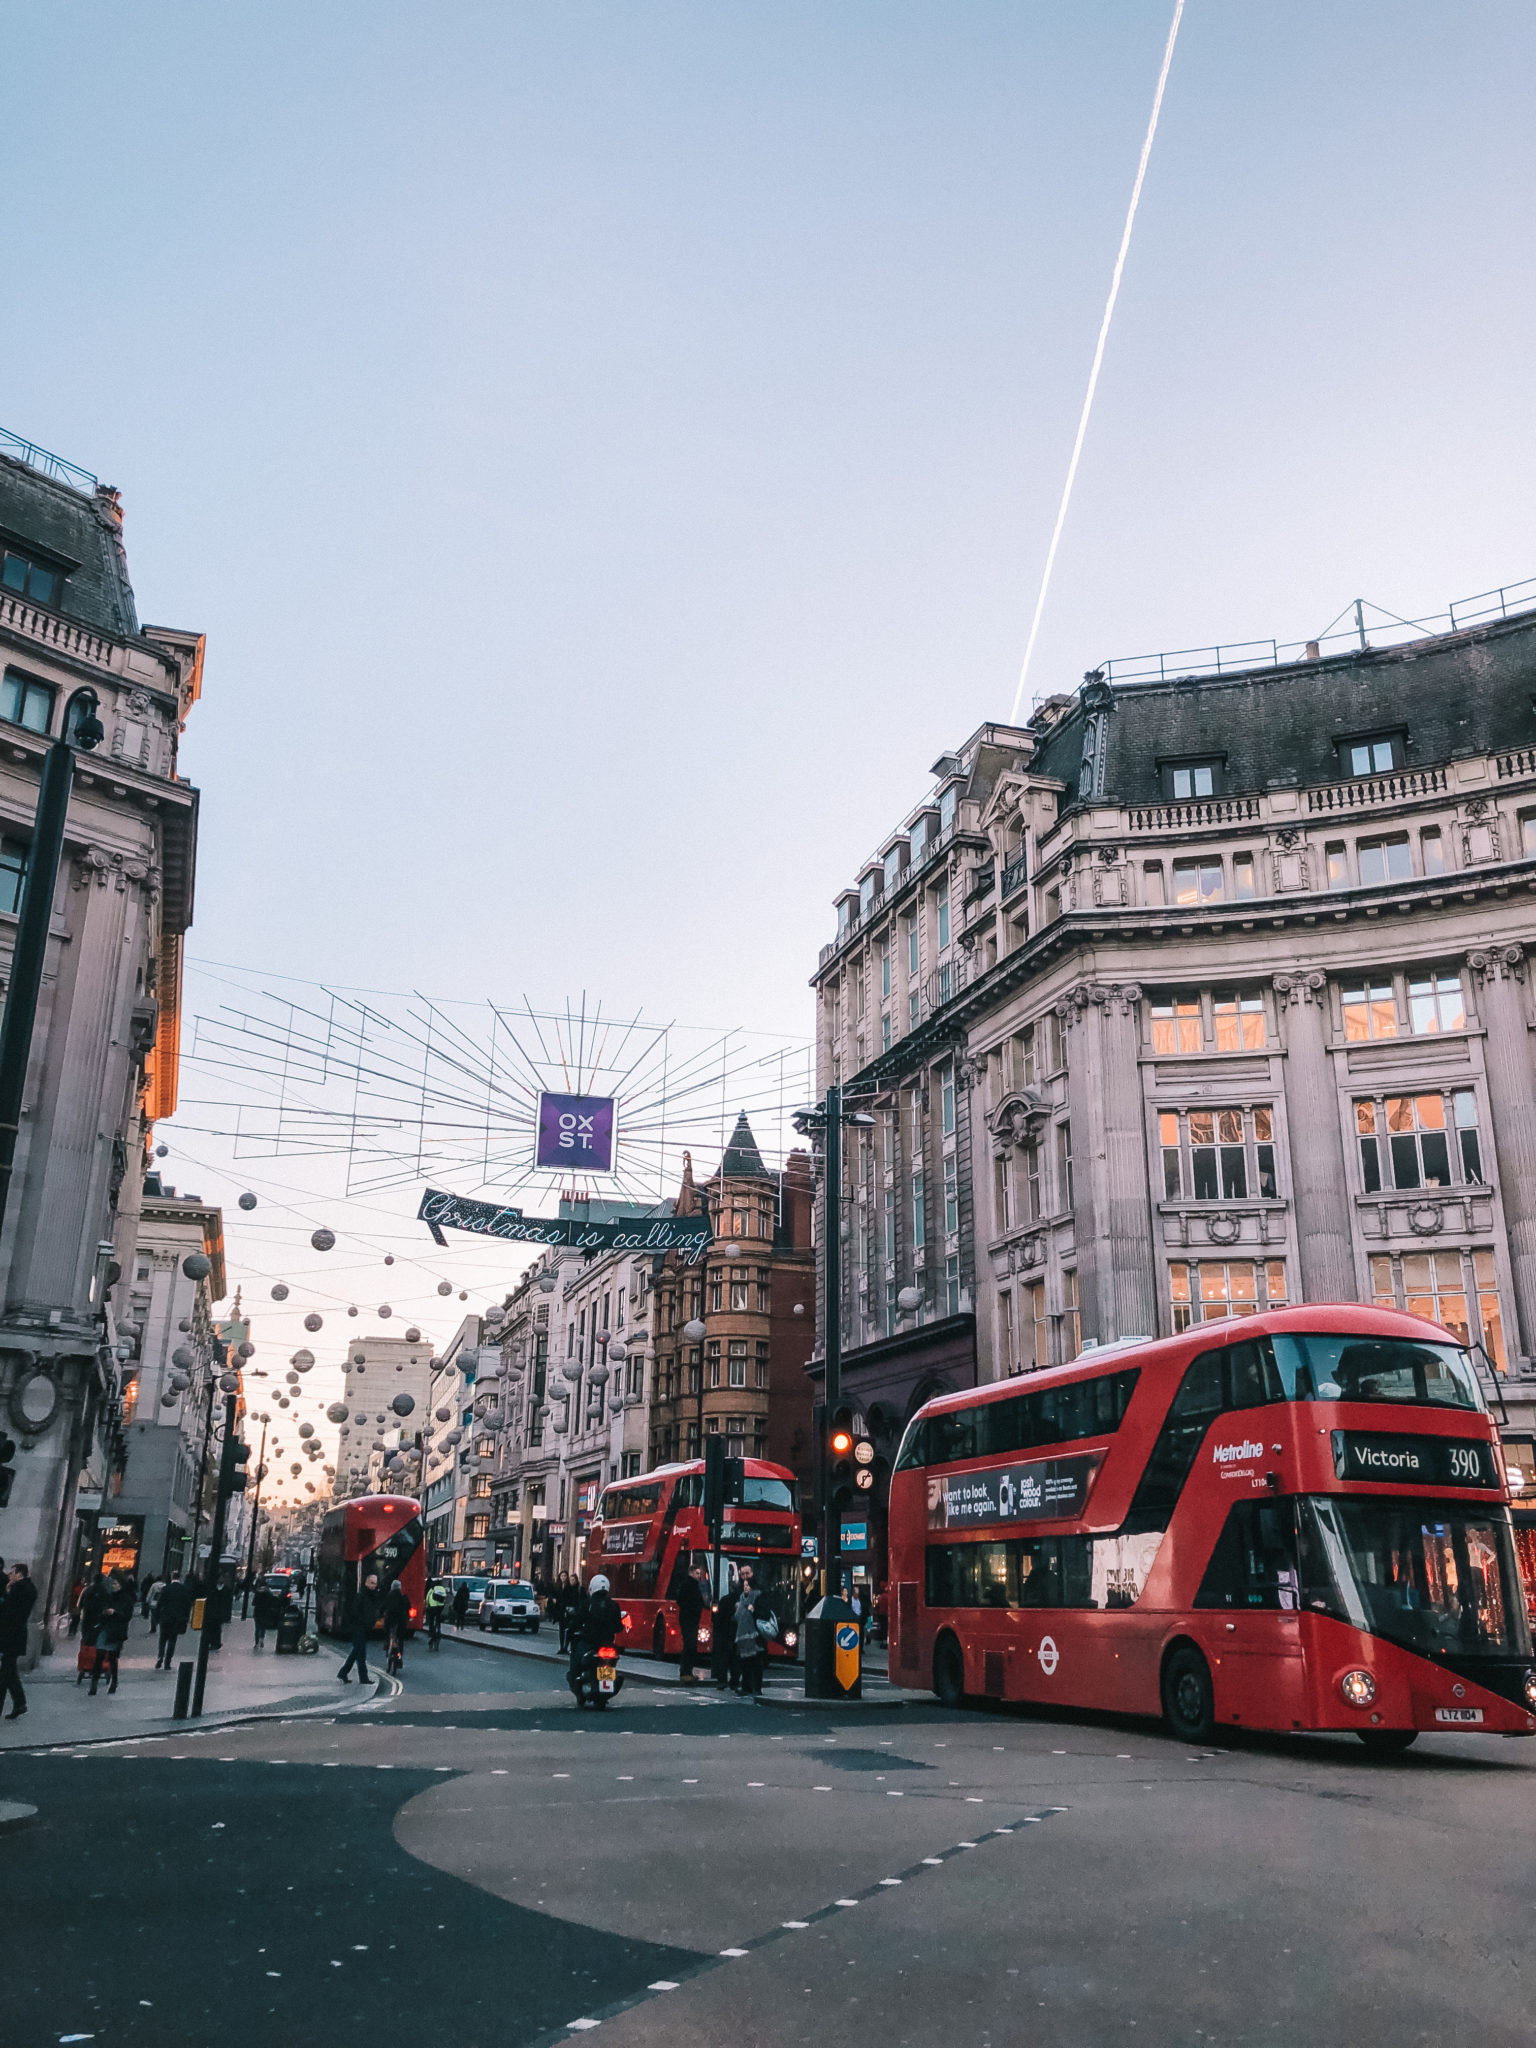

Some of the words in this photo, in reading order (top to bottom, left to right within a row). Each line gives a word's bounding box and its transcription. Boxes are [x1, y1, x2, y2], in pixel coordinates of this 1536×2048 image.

[558, 1113, 594, 1131] OX
[558, 1131, 593, 1149] ST.
[422, 1193, 568, 1244] Christmas
[576, 1223, 604, 1247] is
[613, 1222, 715, 1265] calling
[1212, 1439, 1264, 1463] Metroline
[1354, 1446, 1420, 1468] Victoria
[1449, 1448, 1480, 1477] 390
[942, 1488, 961, 1503] want
[962, 1487, 971, 1500] to
[971, 1483, 988, 1499] look
[1022, 1484, 1041, 1498] wood
[947, 1501, 960, 1516] like
[960, 1503, 972, 1515] me
[973, 1498, 997, 1517] again.
[384, 1547, 398, 1558] 390
[602, 1680, 611, 1690] L
[1441, 1709, 1459, 1721] LTZ
